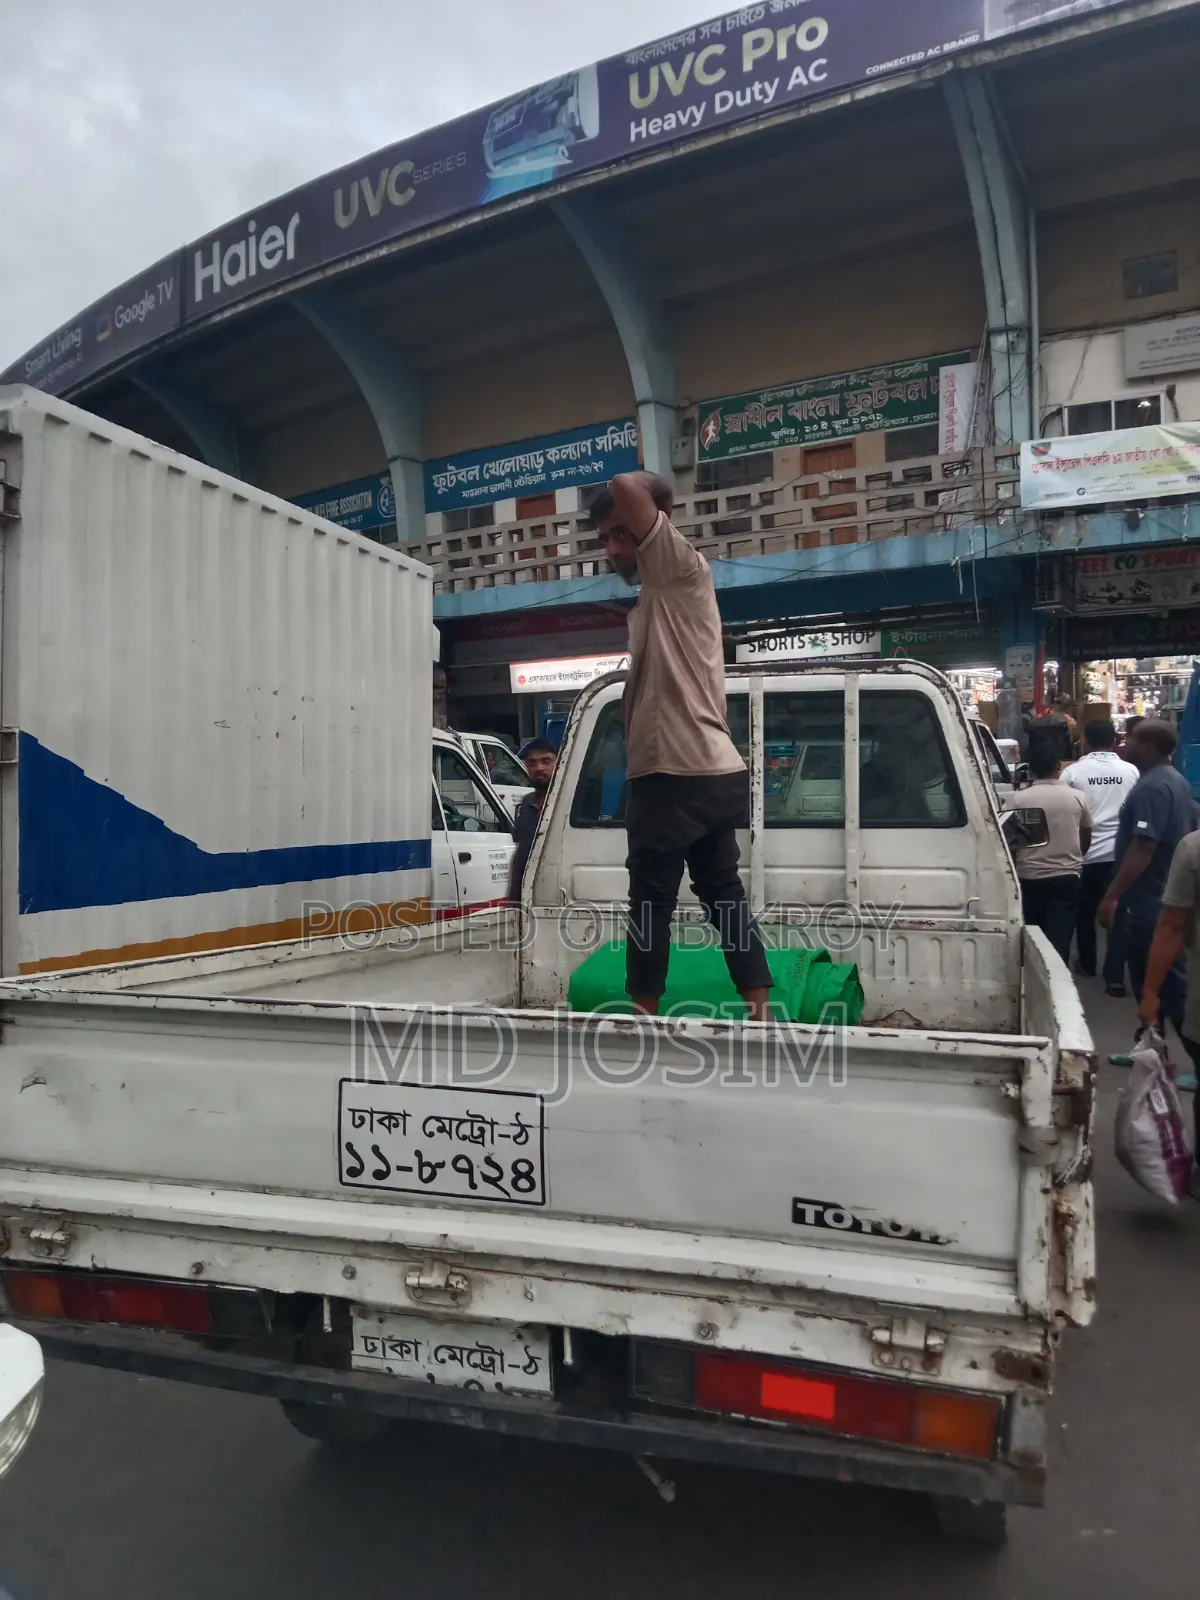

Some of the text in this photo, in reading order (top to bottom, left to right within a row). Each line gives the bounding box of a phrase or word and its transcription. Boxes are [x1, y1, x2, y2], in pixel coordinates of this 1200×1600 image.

[625, 29, 696, 64] বাংলাদেশের
[699, 19, 722, 38] সব
[726, 4, 765, 31] চাইতে
[866, 33, 980, 75] CONNECTED AC BRAND
[629, 16, 829, 109] UVC Pro
[629, 58, 829, 143] Heavy Duty AC
[333, 152, 467, 229] UVC SERIES
[194, 211, 300, 302] Haier
[114, 277, 175, 329] Google TV
[24, 346, 51, 379] Smart
[52, 326, 82, 359] Living
[724, 400, 783, 435] স্বাধীন
[788, 392, 840, 419] বাংলা
[845, 379, 927, 418] ফুটবল
[432, 421, 638, 496] ফুটবল খেলোয়াড় কল্যাণ সমিতি
[748, 631, 875, 653] SPORTS SHOP
[1088, 776, 1123, 786] WUSHU
[348, 1105, 533, 1149] ঢাকা মেট্রো-ঠ
[344, 1140, 536, 1200] ১১-৮৭২৪
[360, 1334, 542, 1376] ঢাকা মেট্রো-ঠ
